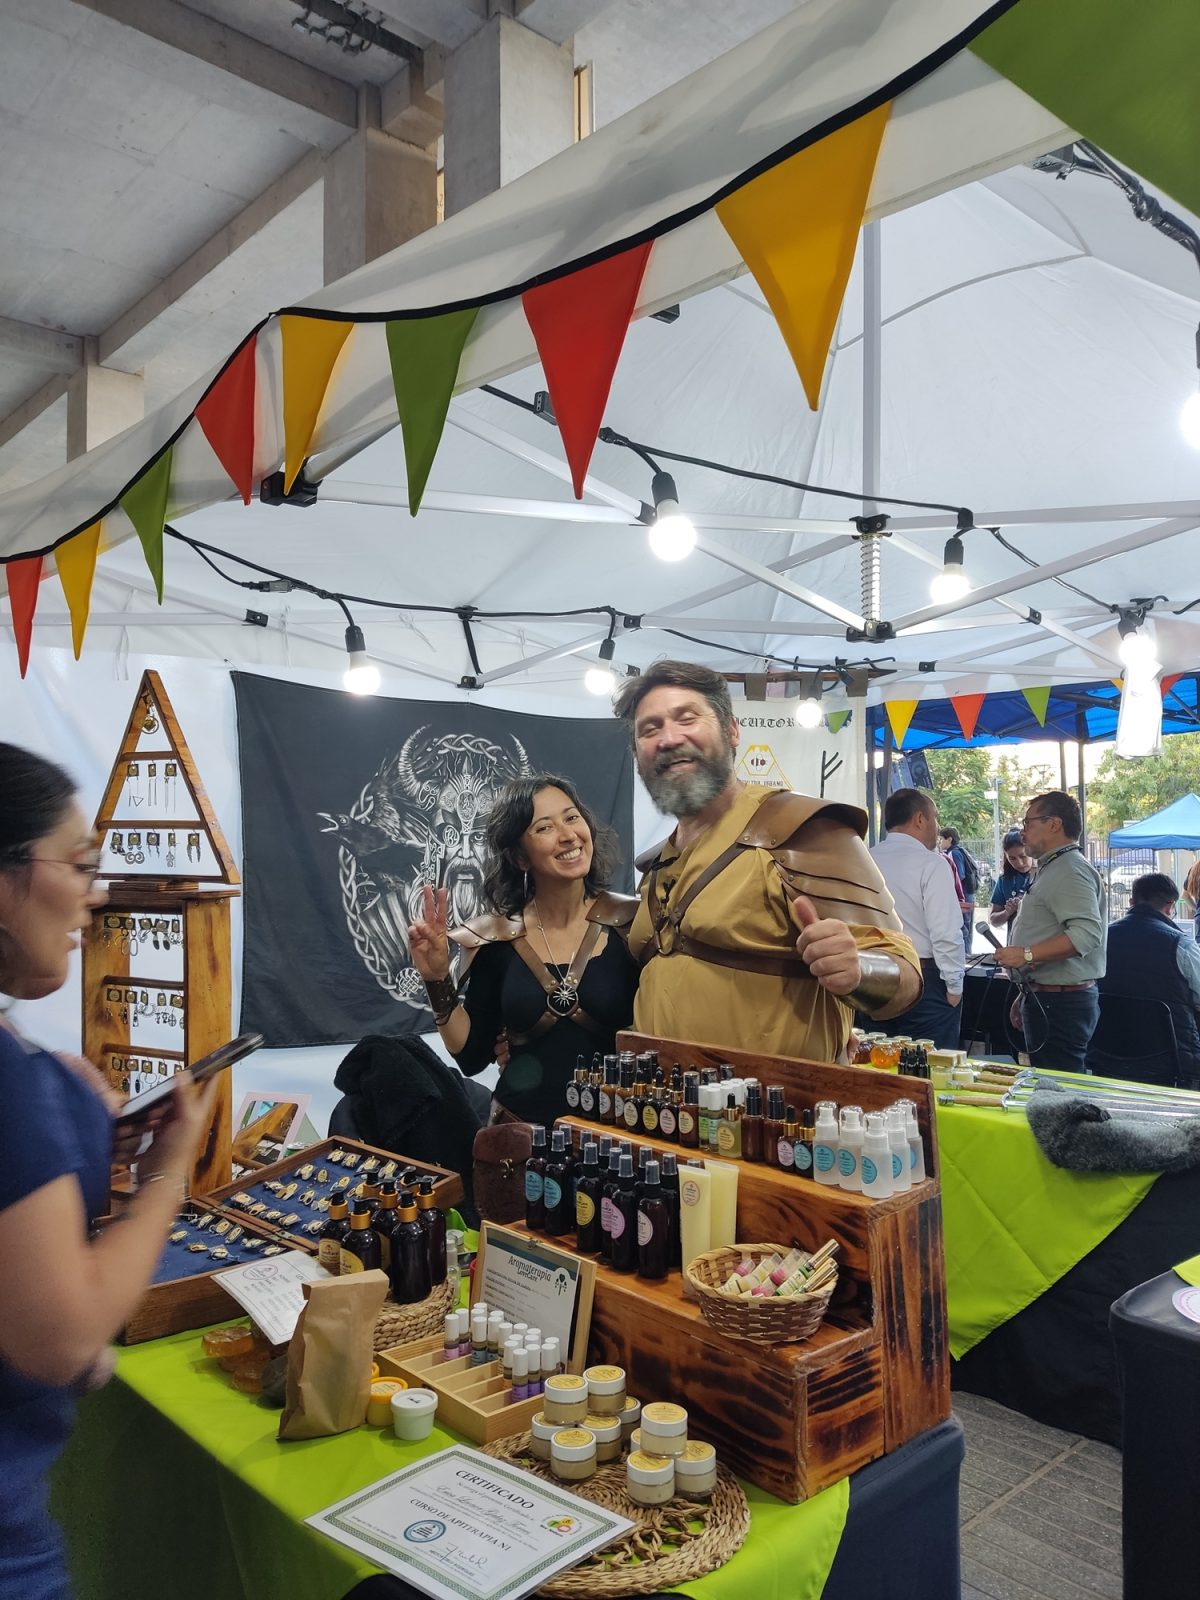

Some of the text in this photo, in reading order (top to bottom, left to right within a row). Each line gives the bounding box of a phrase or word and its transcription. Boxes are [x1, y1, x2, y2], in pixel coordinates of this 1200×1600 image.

[508, 1255, 552, 1282] Aromaterapia
[455, 1469, 535, 1509] CERTIFICADO
[410, 1497, 439, 1514] CURSO
[437, 1511, 450, 1520] DE
[447, 1516, 498, 1546] APITERAPIA
